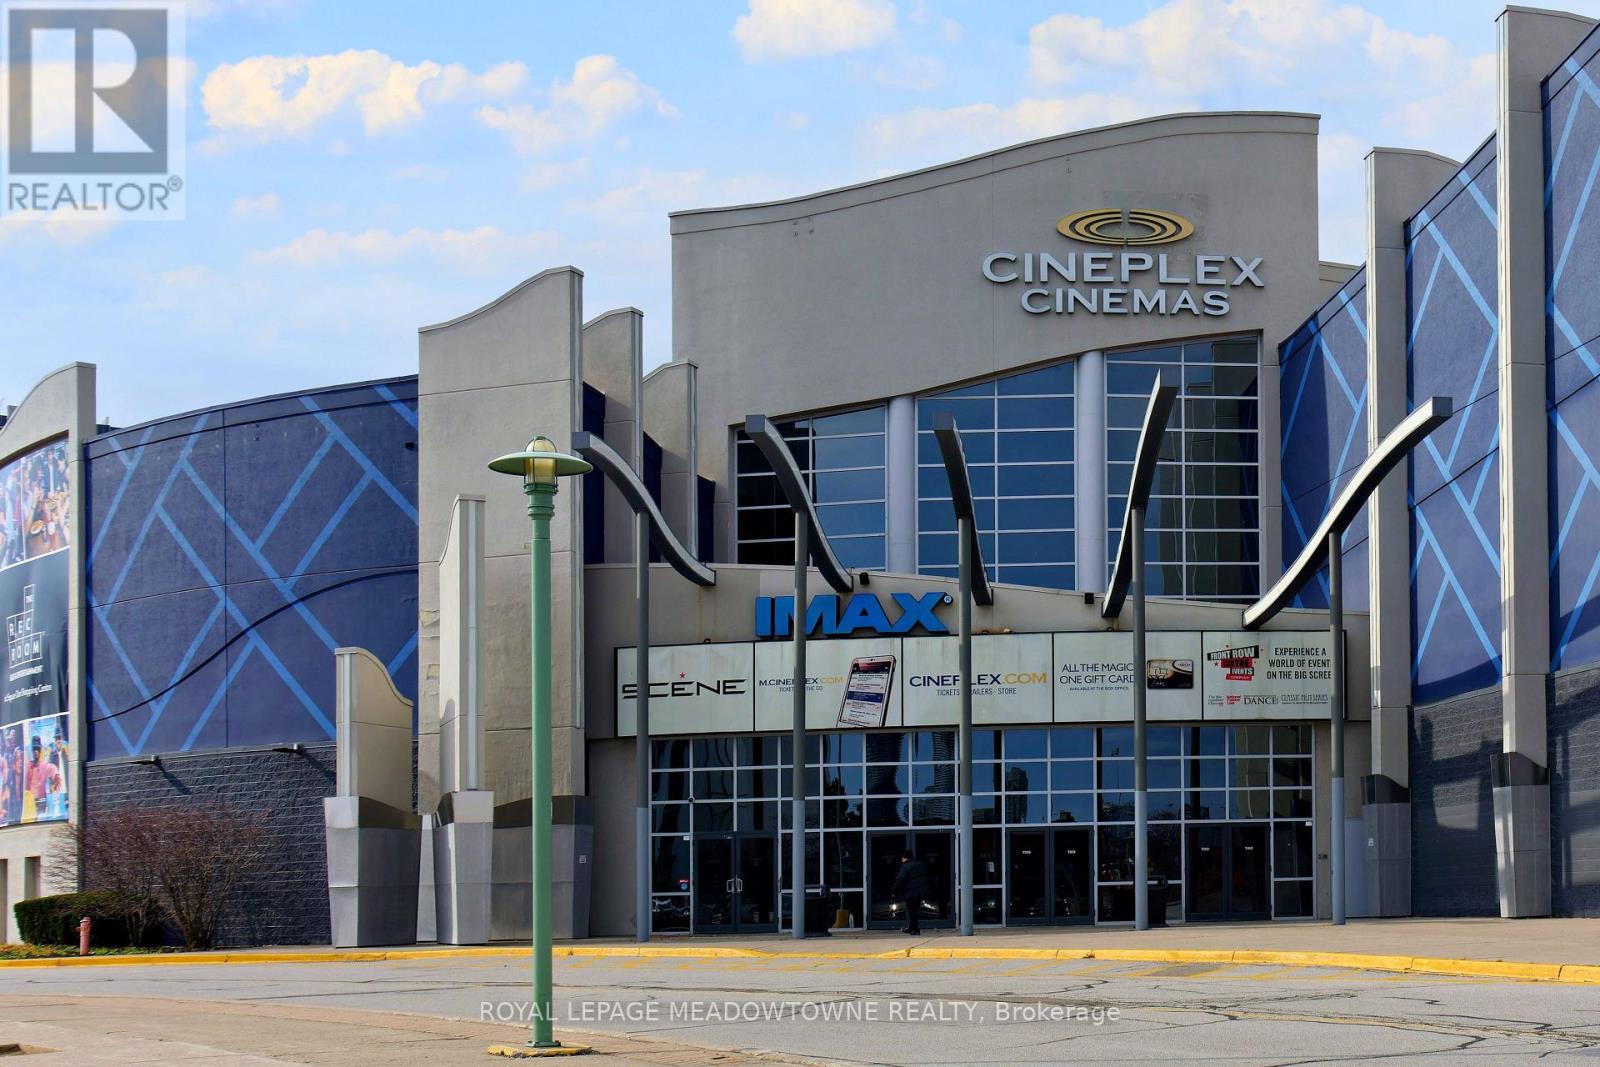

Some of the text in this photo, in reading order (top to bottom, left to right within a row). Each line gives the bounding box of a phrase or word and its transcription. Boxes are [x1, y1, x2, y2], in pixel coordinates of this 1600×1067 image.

[982, 252, 1265, 287] CINEPLEX
[1021, 288, 1231, 316] CINEMAS
[9, 618, 31, 636] REC
[1210, 646, 1255, 660] FRONT ROW
[1274, 647, 1327, 656] EXPERIENCE A
[1061, 662, 1134, 672] ALL THE MAGIC
[1268, 659, 1295, 668] WORLD
[1296, 659, 1307, 668] OF
[1059, 675, 1082, 684] ONE
[1084, 675, 1106, 684] GIFT
[1266, 670, 1277, 680] ON
[1279, 670, 1293, 680] THE
[1294, 670, 1308, 680] BIG
[622, 679, 748, 699] SCENE
[997, 687, 1017, 695] STORE
